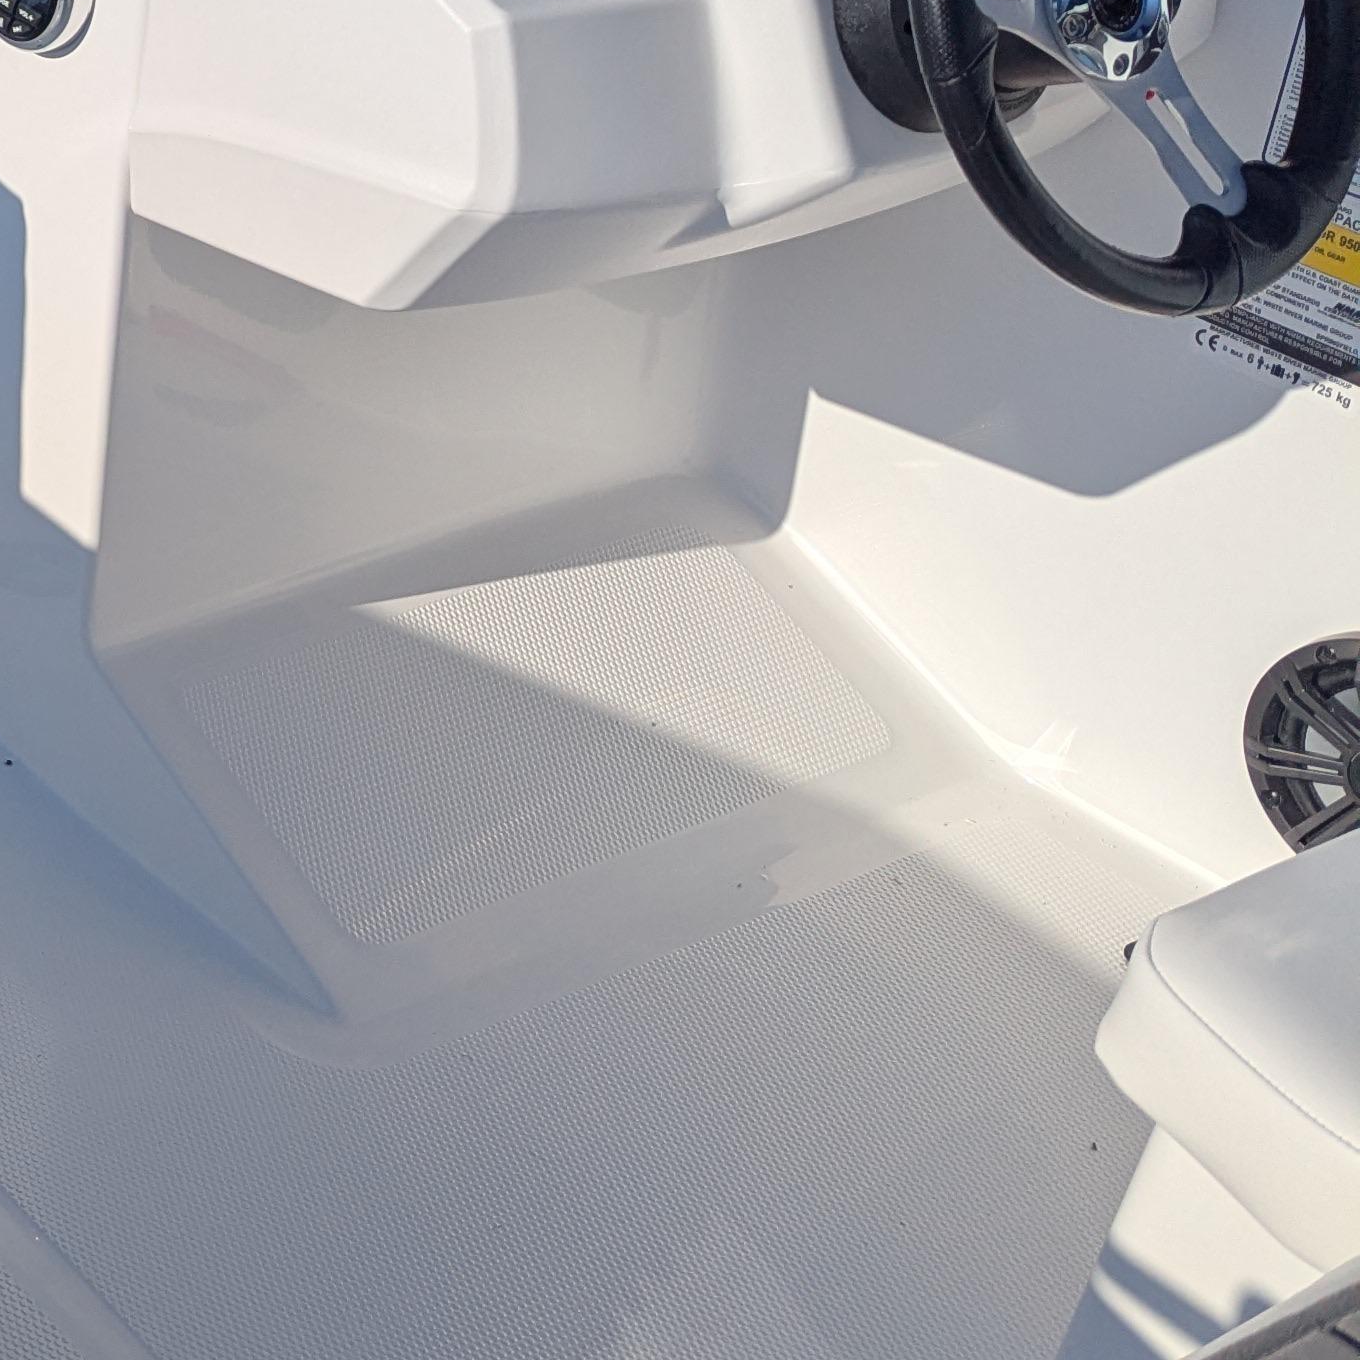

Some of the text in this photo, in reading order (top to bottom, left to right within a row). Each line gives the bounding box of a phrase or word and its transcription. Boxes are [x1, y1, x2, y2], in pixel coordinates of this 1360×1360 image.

[1292, 272, 1316, 287] EFFECT
[1319, 274, 1341, 288] COAST
[1246, 353, 1254, 364] 6
[1311, 381, 1333, 399] 725
[1335, 392, 1352, 410] kg
